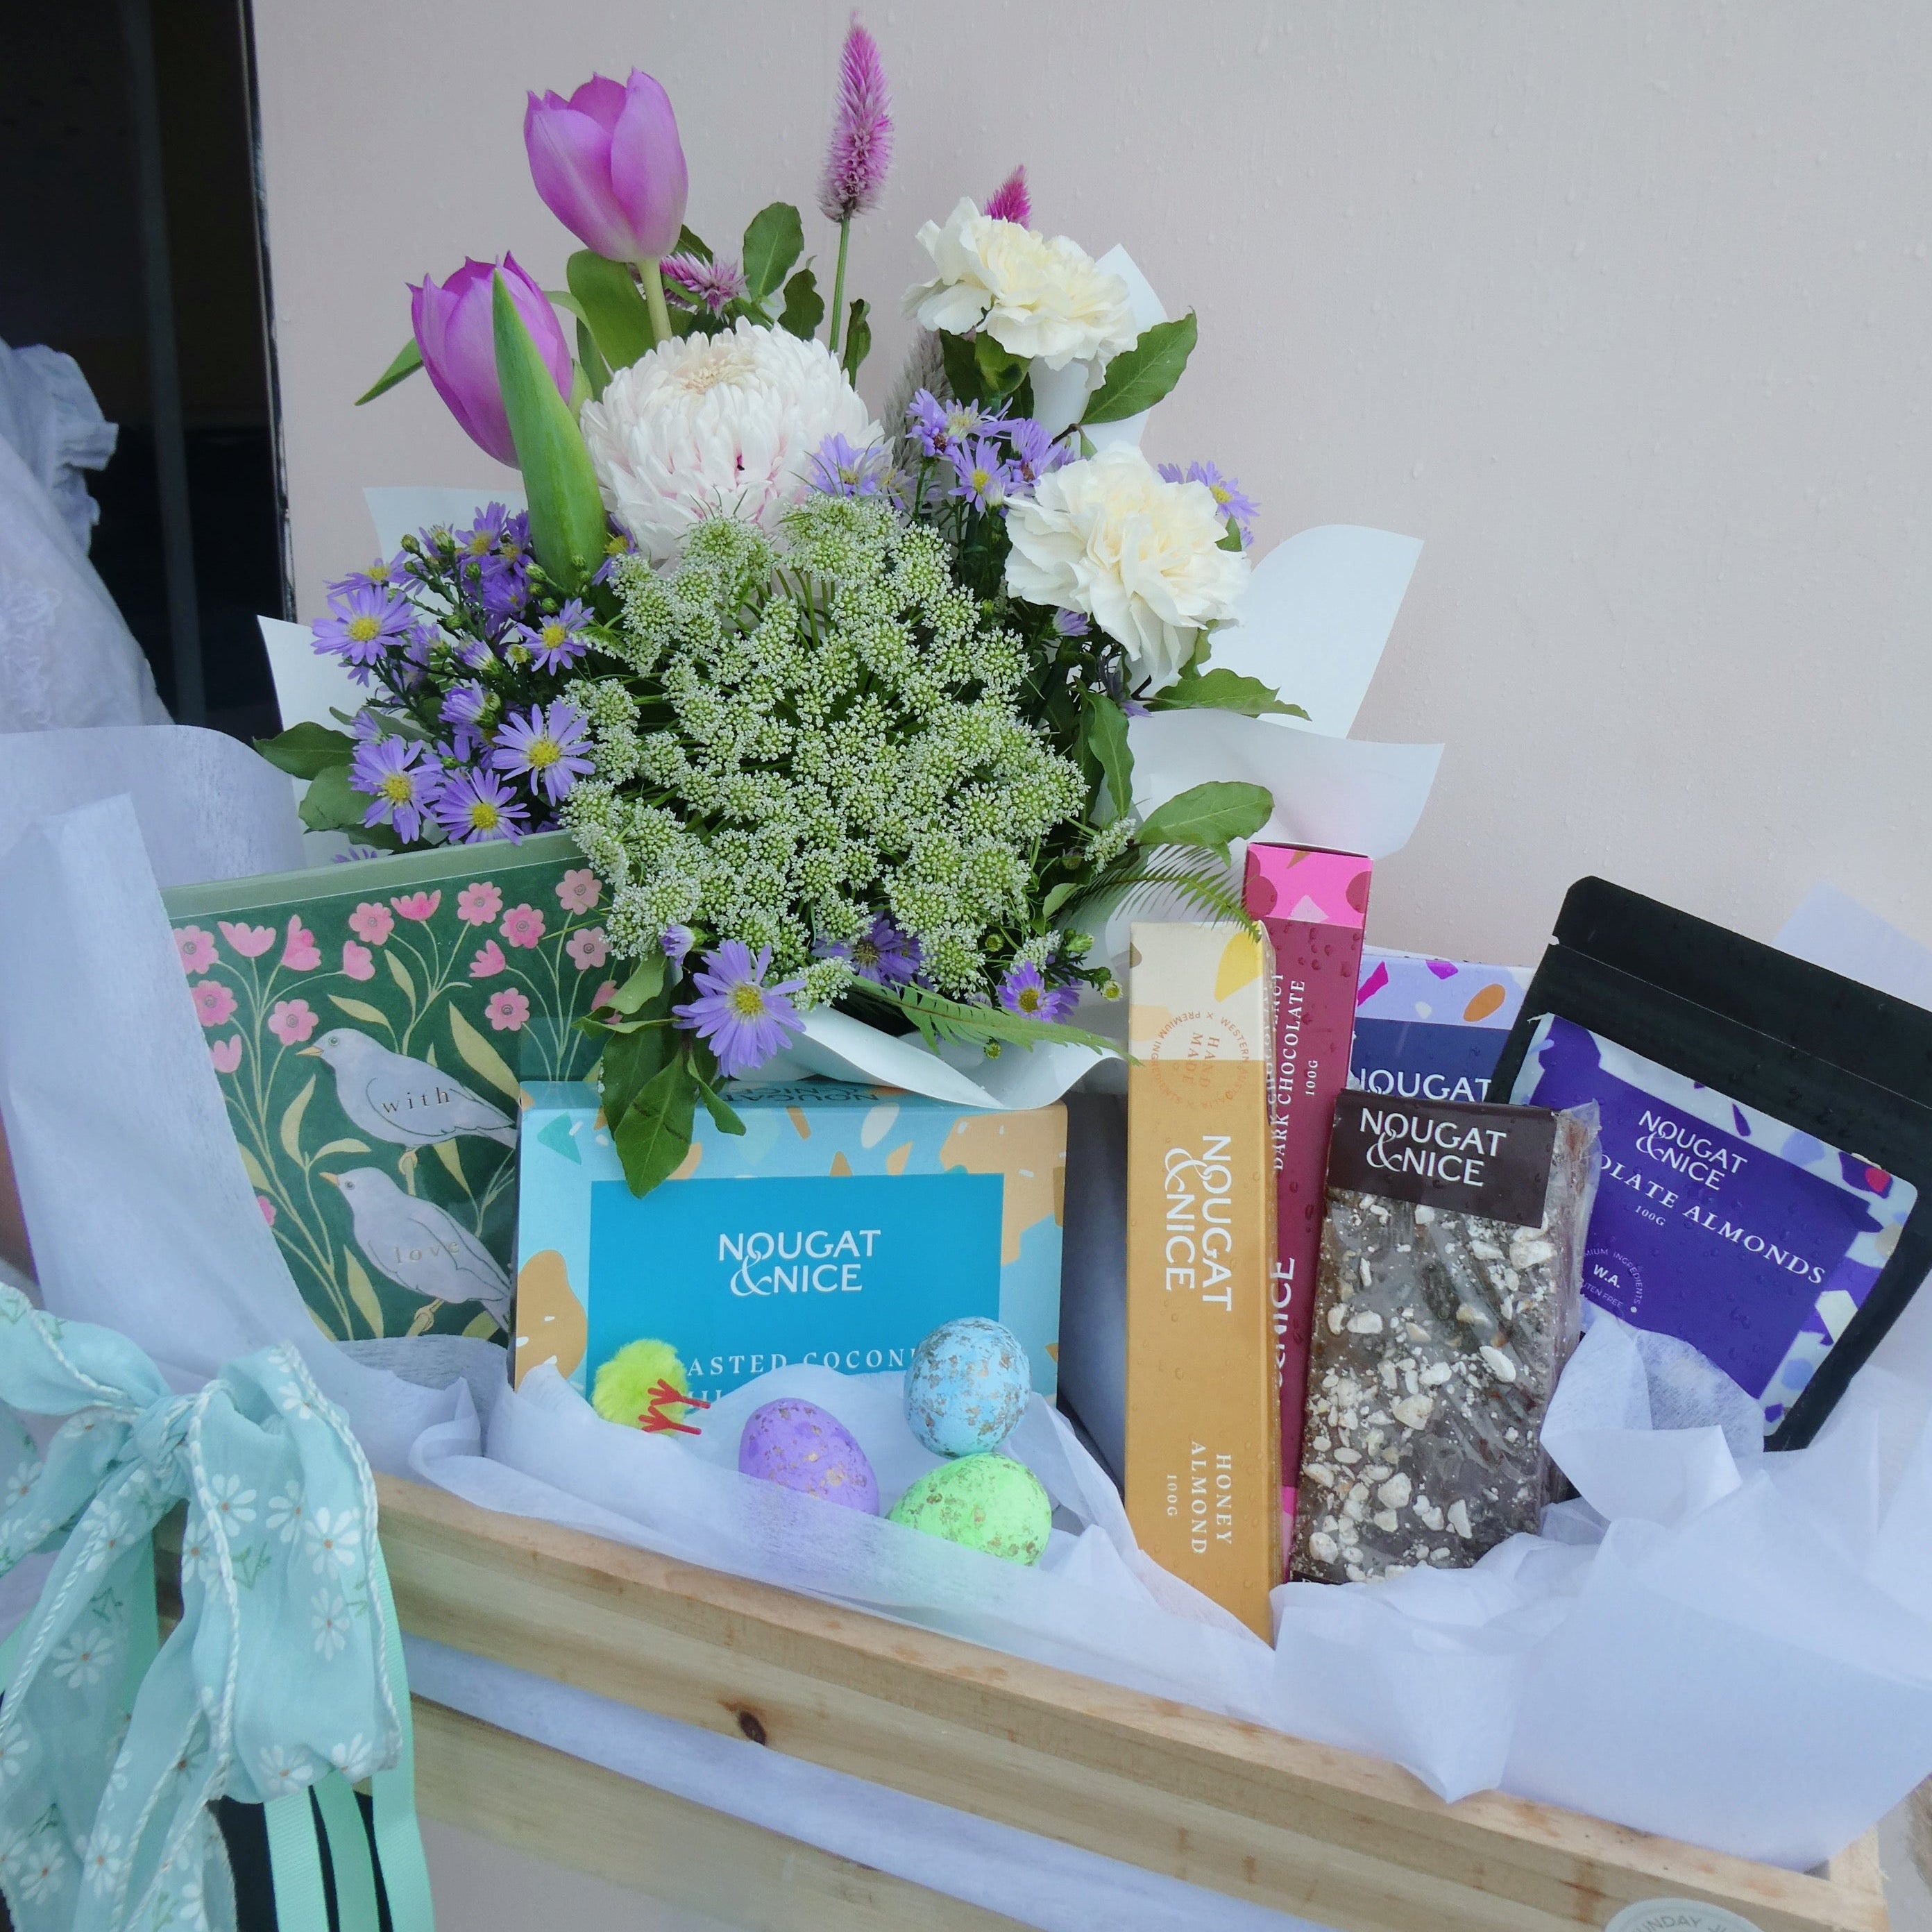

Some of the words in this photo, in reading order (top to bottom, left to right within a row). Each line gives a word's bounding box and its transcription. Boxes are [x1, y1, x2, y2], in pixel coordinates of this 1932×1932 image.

[1158, 1011, 1201, 1038] PREMIUM
[1221, 1017, 1250, 1063] WESTERN
[1277, 980, 1305, 1105] CHOCOLATE
[1182, 1032, 1203, 1087] MADE
[1199, 1036, 1220, 1087] HAND
[1305, 1059, 1319, 1096] 100G
[382, 1087, 450, 1114] with
[1360, 1108, 1507, 1158] NOUGAT
[1366, 1128, 1485, 1187] &NICE
[1638, 1110, 1747, 1173] NOUGAT
[1636, 1131, 1725, 1191] &NICE
[1164, 1148, 1212, 1291] &NICE
[1202, 1135, 1232, 1312] NOUGAT
[1600, 1154, 1679, 1208] OLATE
[1682, 1205, 1826, 1284] ALMONDS
[1634, 1205, 1666, 1227] 100G
[395, 1242, 460, 1264] love
[718, 1229, 881, 1262] NOUGAT
[730, 1250, 863, 1297] &NICE
[1593, 1264, 1620, 1288] W.A.
[1613, 1251, 1643, 1305] INGREDIENTS
[1602, 1293, 1624, 1308] FREE
[687, 1354, 787, 1377] ASTED
[803, 1348, 917, 1370] COCON
[1167, 1474, 1178, 1517] 100G
[1191, 1441, 1207, 1554] ALMOND
[1216, 1454, 1232, 1545] HONEY
